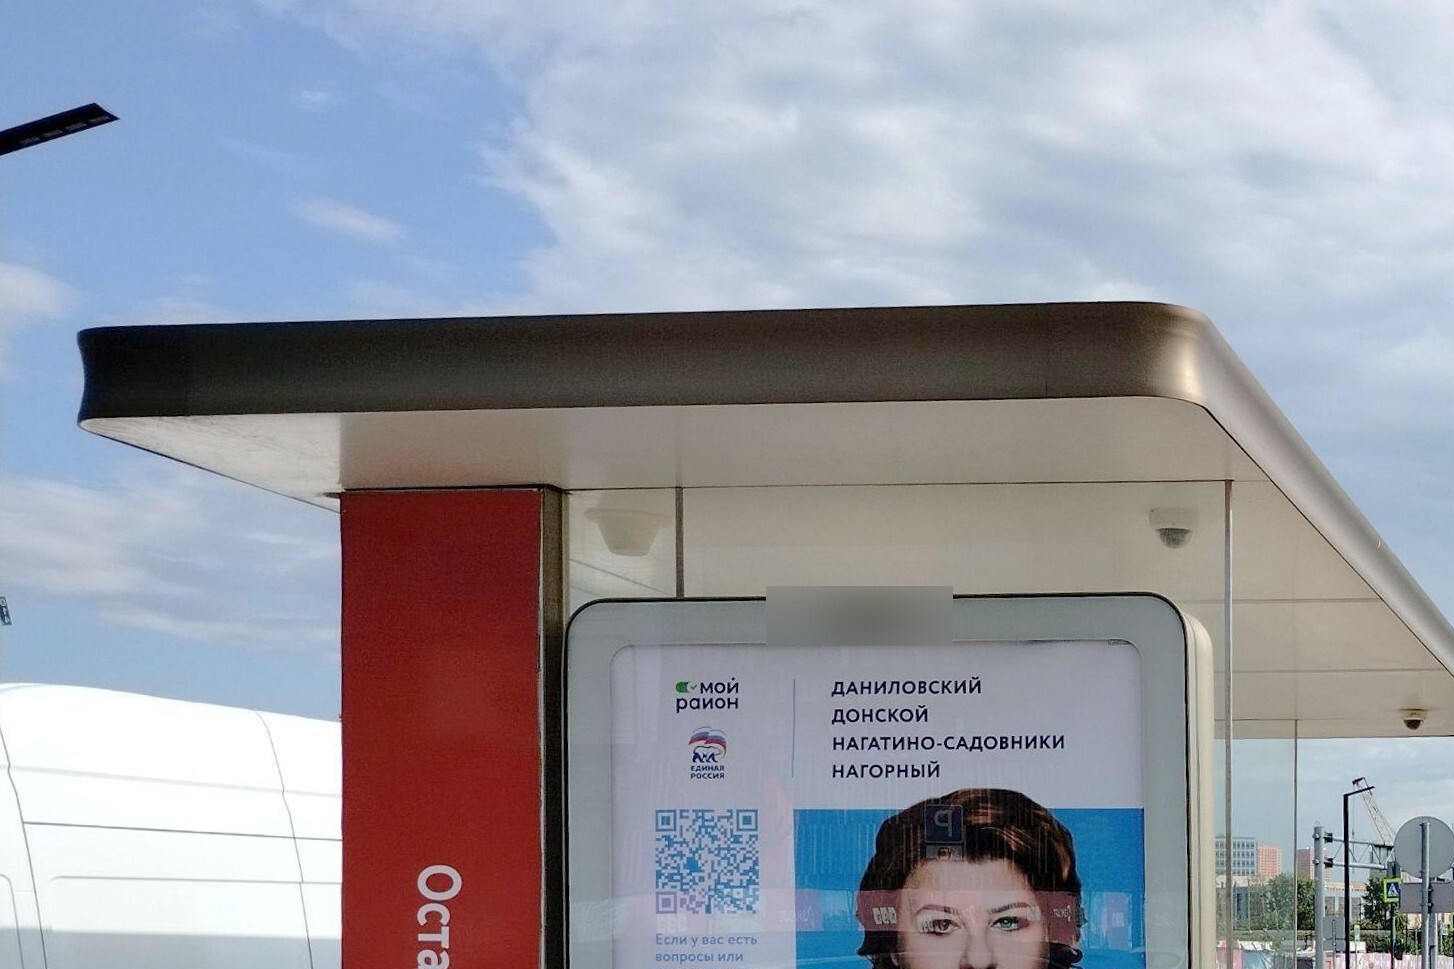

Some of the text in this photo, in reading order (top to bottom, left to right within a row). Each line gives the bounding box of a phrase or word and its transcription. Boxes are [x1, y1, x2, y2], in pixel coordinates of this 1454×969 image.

[831, 677, 982, 697] ДАНИЛОВСКИЙ
[831, 705, 928, 725] ДОНСКОЙ
[832, 734, 1065, 753] НАГАТИНО-САДОВНИКИ
[832, 761, 940, 779] НАГОРНЫЙ
[655, 933, 758, 948] Если у вас есть
[655, 953, 744, 965] вопросы или
